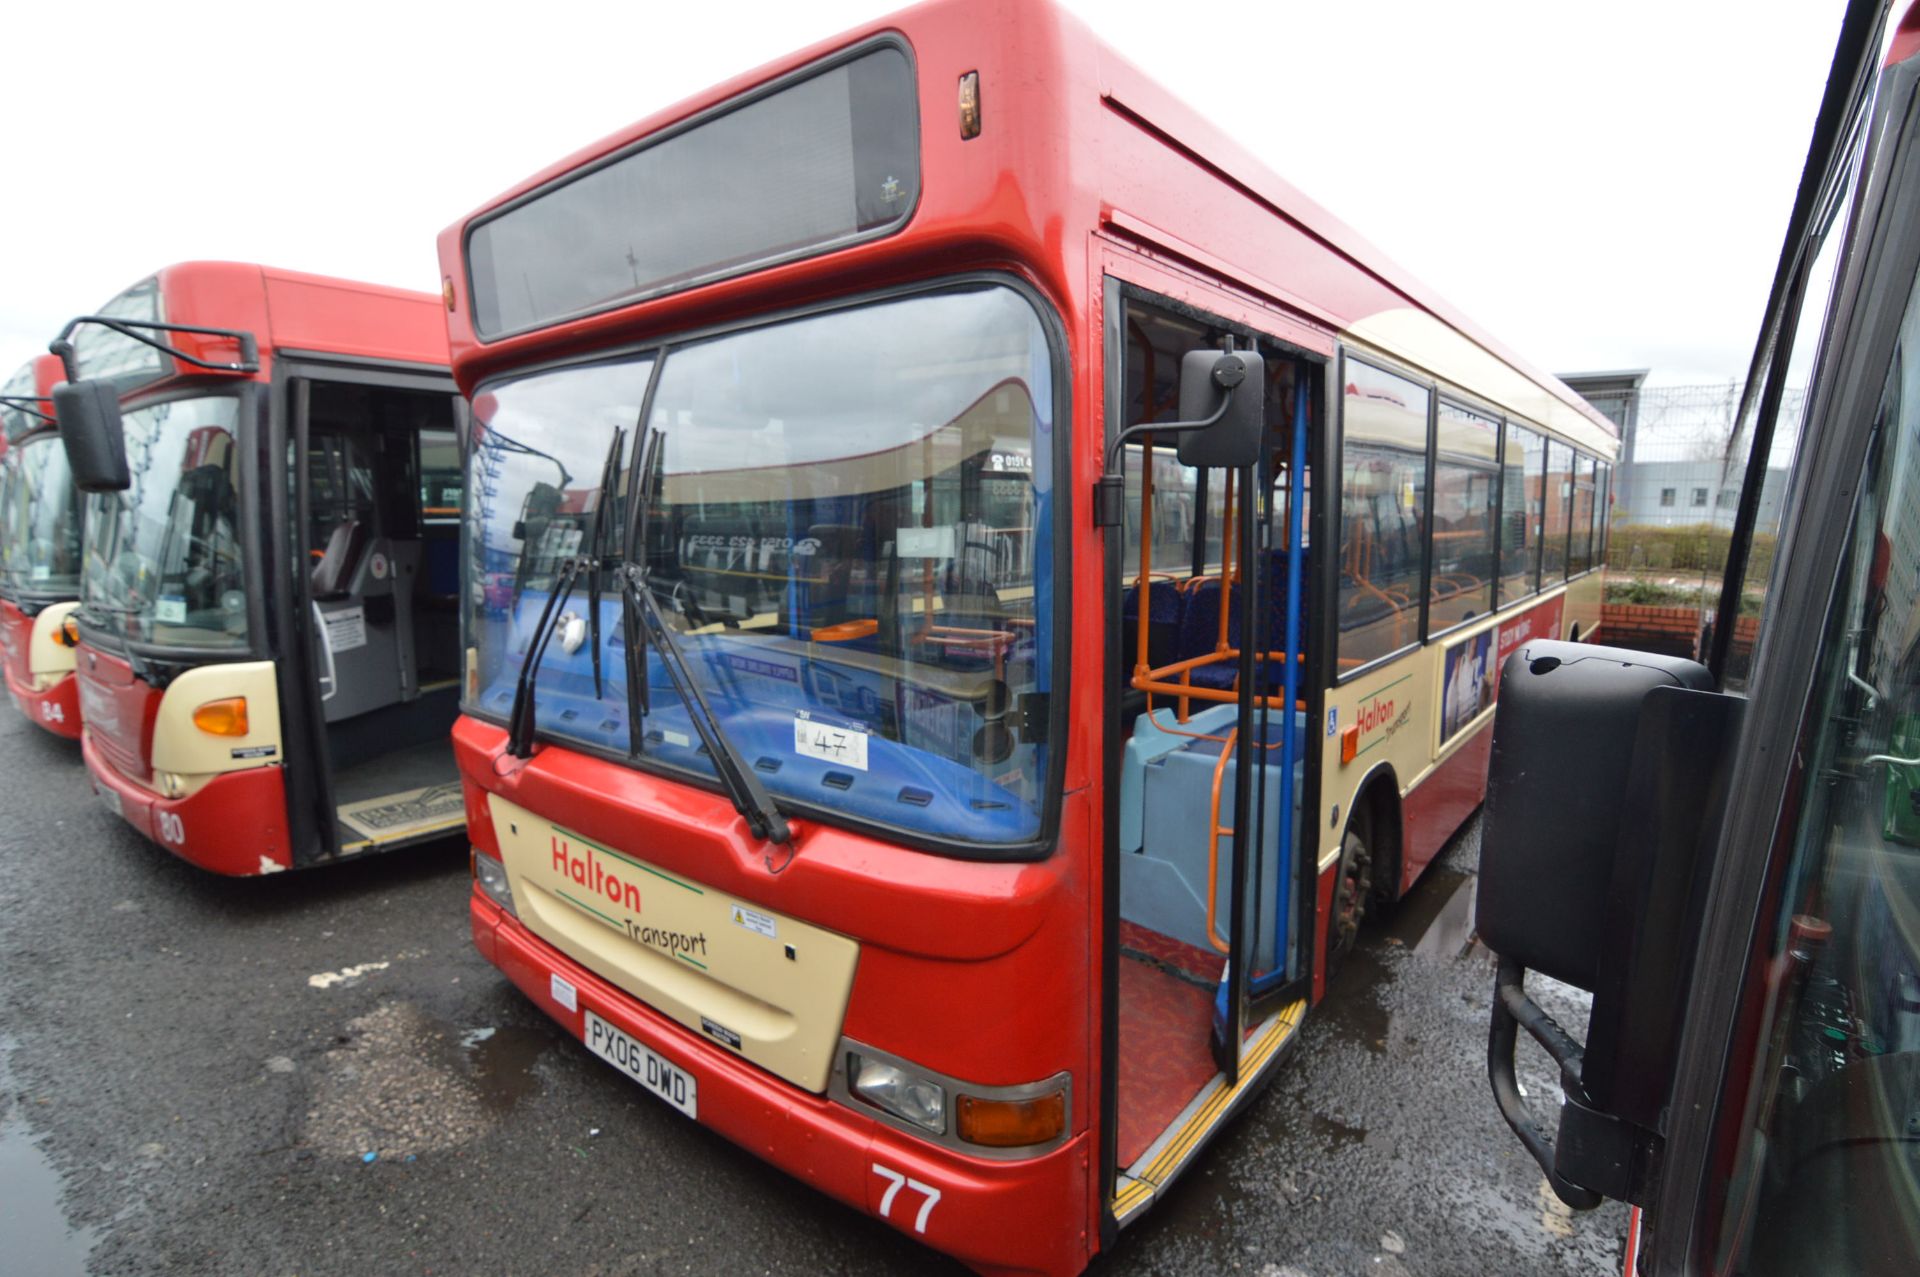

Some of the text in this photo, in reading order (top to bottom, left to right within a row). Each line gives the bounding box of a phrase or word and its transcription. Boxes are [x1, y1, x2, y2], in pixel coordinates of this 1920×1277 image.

[1005, 455, 1025, 468] 0151
[1356, 697, 1394, 736] Halton
[814, 730, 848, 757] 47
[159, 811, 186, 845] 80
[552, 835, 641, 914] Halton
[624, 918, 707, 957] Transport
[592, 1018, 686, 1106] PX06 DWD
[872, 1162, 942, 1234] 77
